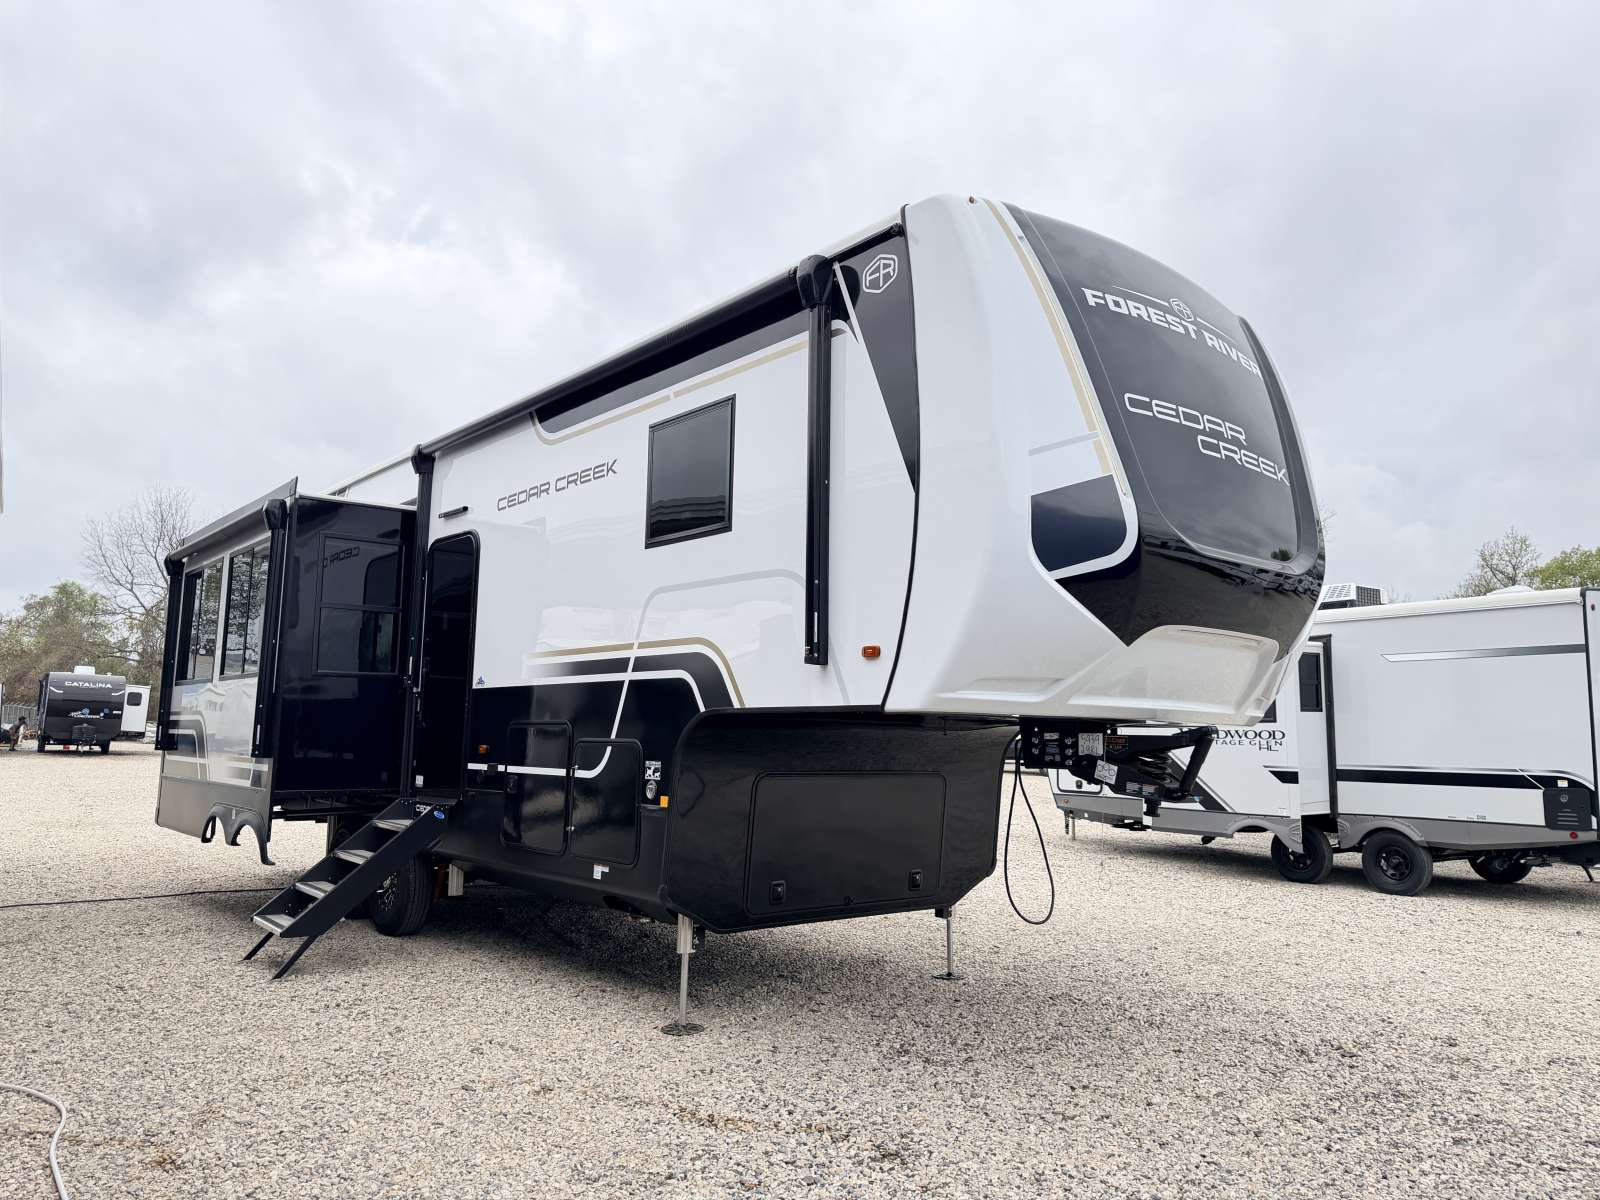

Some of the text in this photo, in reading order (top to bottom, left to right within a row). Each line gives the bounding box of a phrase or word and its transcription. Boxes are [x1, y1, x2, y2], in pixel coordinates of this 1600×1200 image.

[1081, 287, 1200, 340] FOREST
[1200, 329, 1264, 380] RIVER
[1124, 392, 1247, 446] CEDAR
[497, 459, 618, 512] CEDAR CREEK
[1197, 434, 1290, 487] CREEK
[65, 681, 113, 689] CATALINA
[1213, 729, 1286, 740] DWOOD
